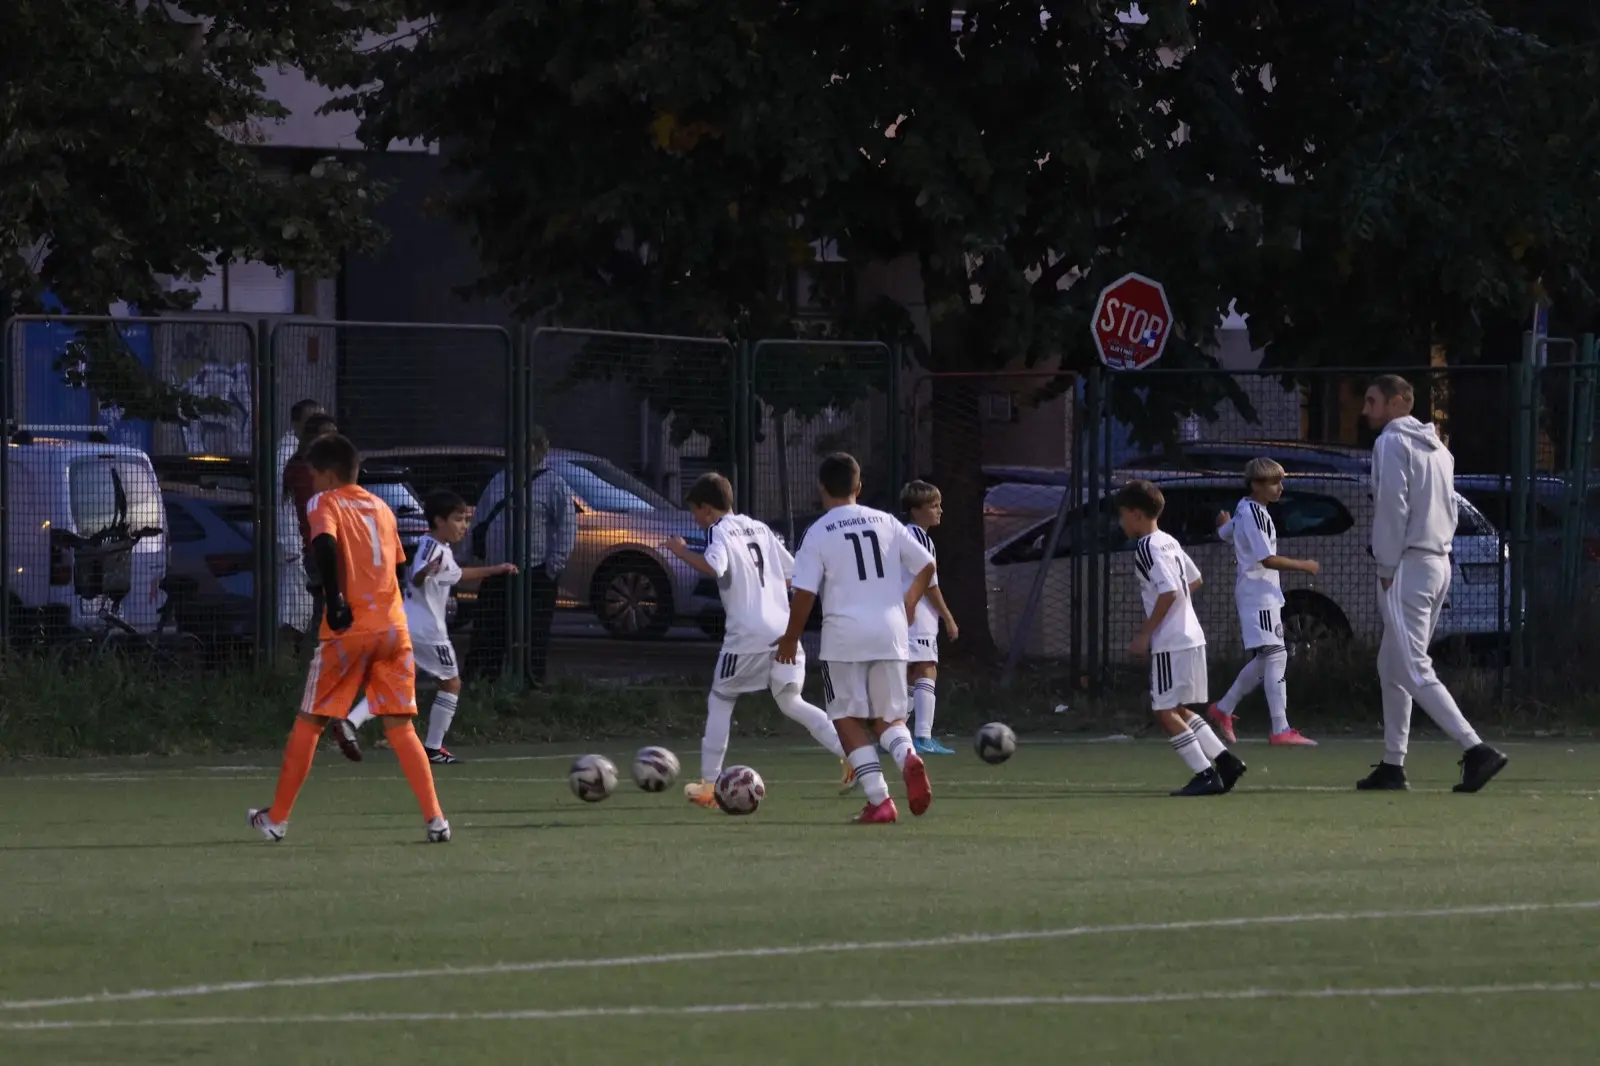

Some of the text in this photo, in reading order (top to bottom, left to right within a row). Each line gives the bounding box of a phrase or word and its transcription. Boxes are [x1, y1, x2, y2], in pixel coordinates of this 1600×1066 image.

[1101, 298, 1163, 343] STOP
[825, 516, 884, 532] NK ZAGREB CITY
[746, 542, 765, 588] 9
[844, 530, 884, 581] 11
